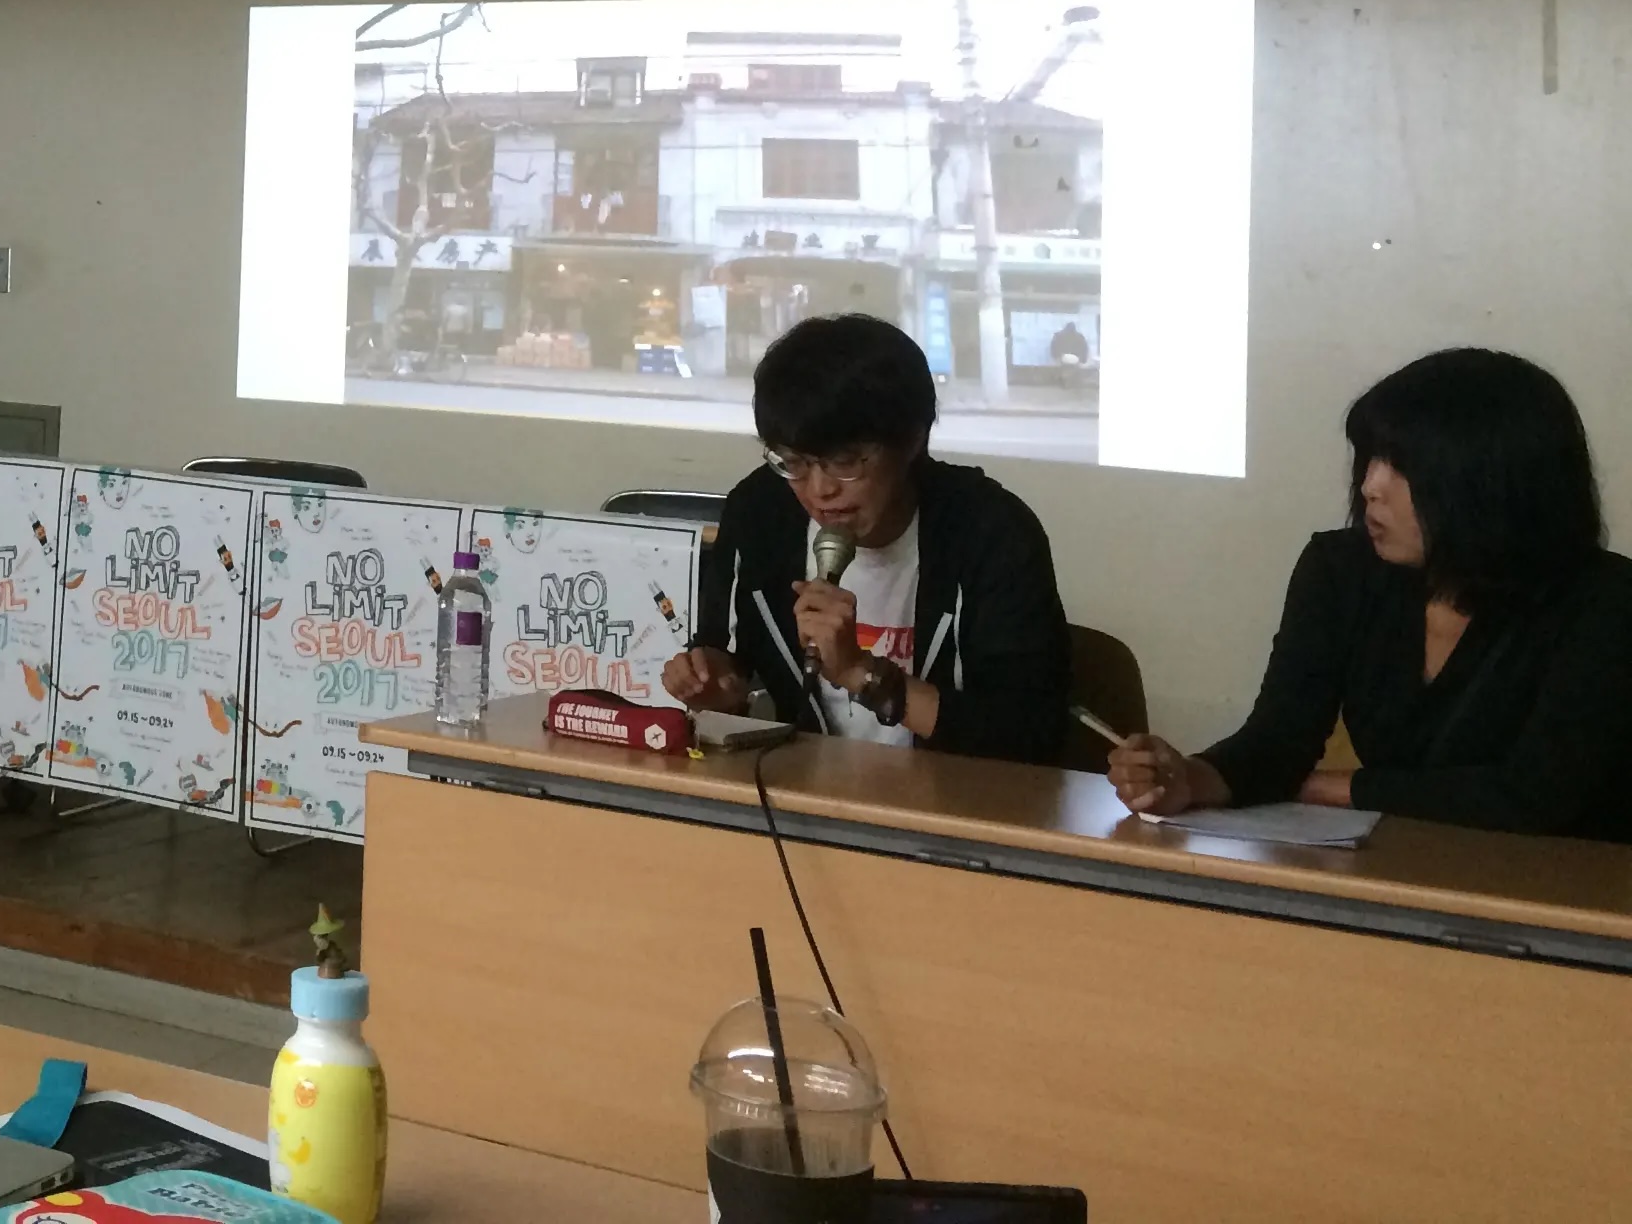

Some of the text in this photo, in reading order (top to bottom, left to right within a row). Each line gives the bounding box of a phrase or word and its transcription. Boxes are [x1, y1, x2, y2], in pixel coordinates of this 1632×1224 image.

[124, 525, 181, 563] NO
[325, 548, 385, 588] NO
[540, 570, 608, 611] NO
[92, 587, 212, 640] SEOUL
[112, 629, 190, 679] 2017
[291, 616, 421, 669] SEOUL
[313, 659, 399, 710] 2017
[503, 641, 651, 698] SEOUL
[554, 714, 565, 728] IS
[566, 716, 584, 732] THE
[585, 720, 628, 739] REWARD
[574, 704, 619, 722] JOURNEY
